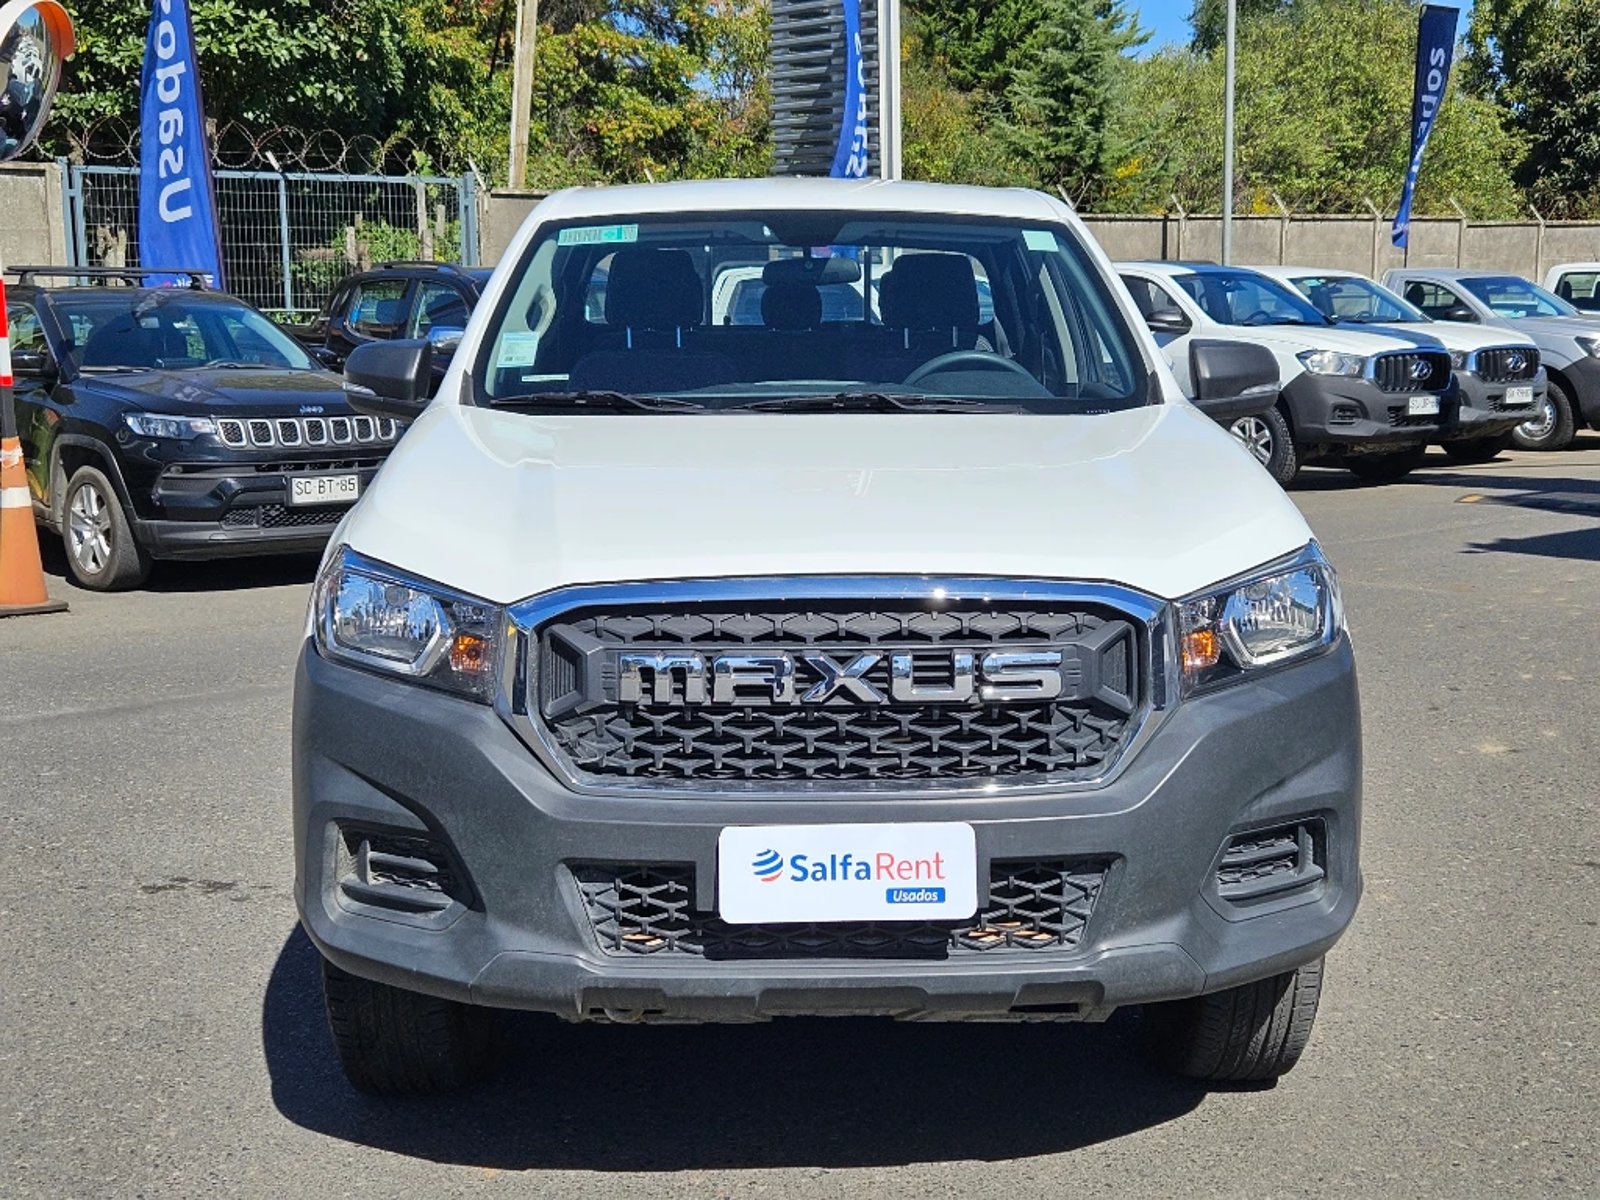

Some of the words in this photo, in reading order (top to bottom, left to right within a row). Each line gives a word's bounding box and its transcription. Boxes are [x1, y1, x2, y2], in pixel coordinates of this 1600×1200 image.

[618, 650, 1064, 704] MAXUS
[789, 852, 946, 882] SalfaRent
[892, 888, 939, 902] Usados
